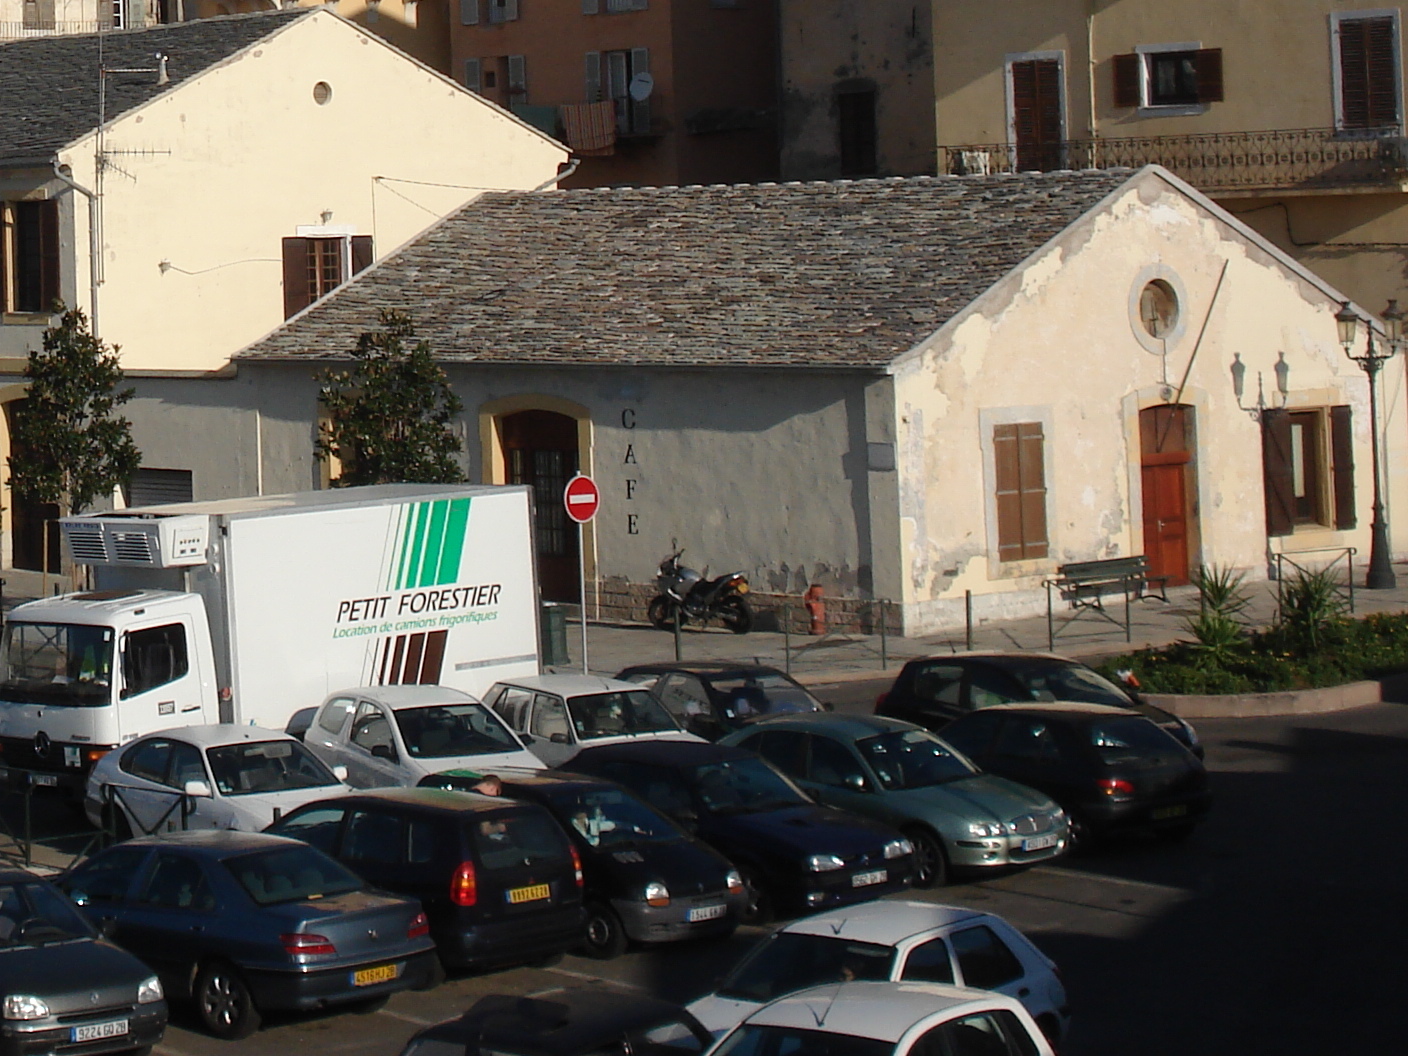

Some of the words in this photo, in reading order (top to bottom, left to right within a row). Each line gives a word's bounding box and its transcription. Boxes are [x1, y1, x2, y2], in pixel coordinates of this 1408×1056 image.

[621, 408, 639, 535] CAFE
[336, 596, 392, 624] PETIT
[397, 584, 502, 616] FORESTIER
[332, 622, 377, 639] Location
[379, 621, 393, 633] de
[394, 616, 437, 631] camions
[438, 610, 498, 629] frigorifiques
